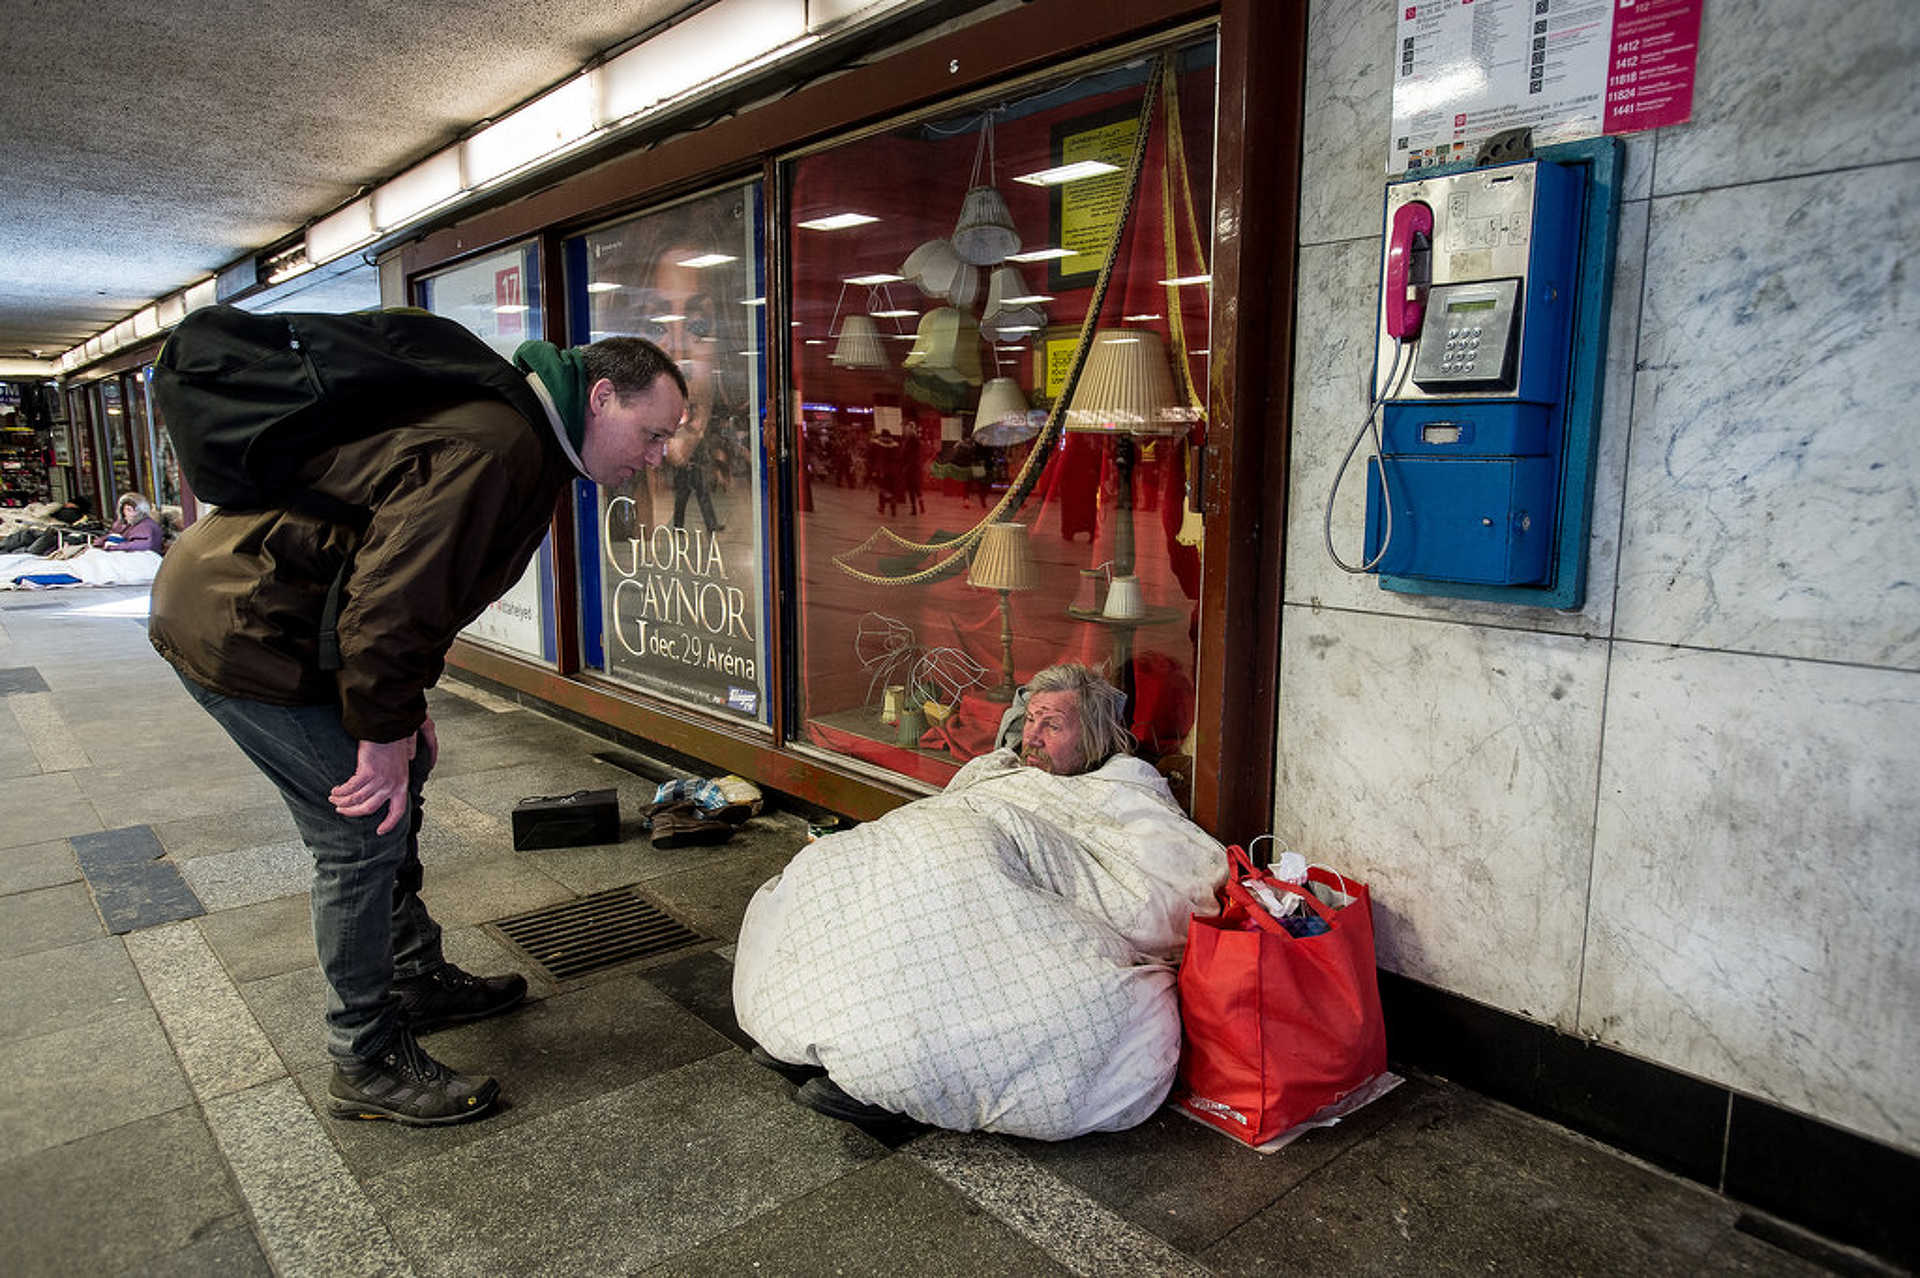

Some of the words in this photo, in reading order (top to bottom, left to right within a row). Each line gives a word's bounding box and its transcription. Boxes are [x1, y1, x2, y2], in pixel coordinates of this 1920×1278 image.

[1616, 56, 1638, 70] 1412
[1617, 40, 1640, 54] 1412
[605, 496, 729, 579] GLORIA
[613, 573, 754, 656] GAYNOR
[650, 629, 679, 659] dec.
[707, 643, 755, 679] Aréna
